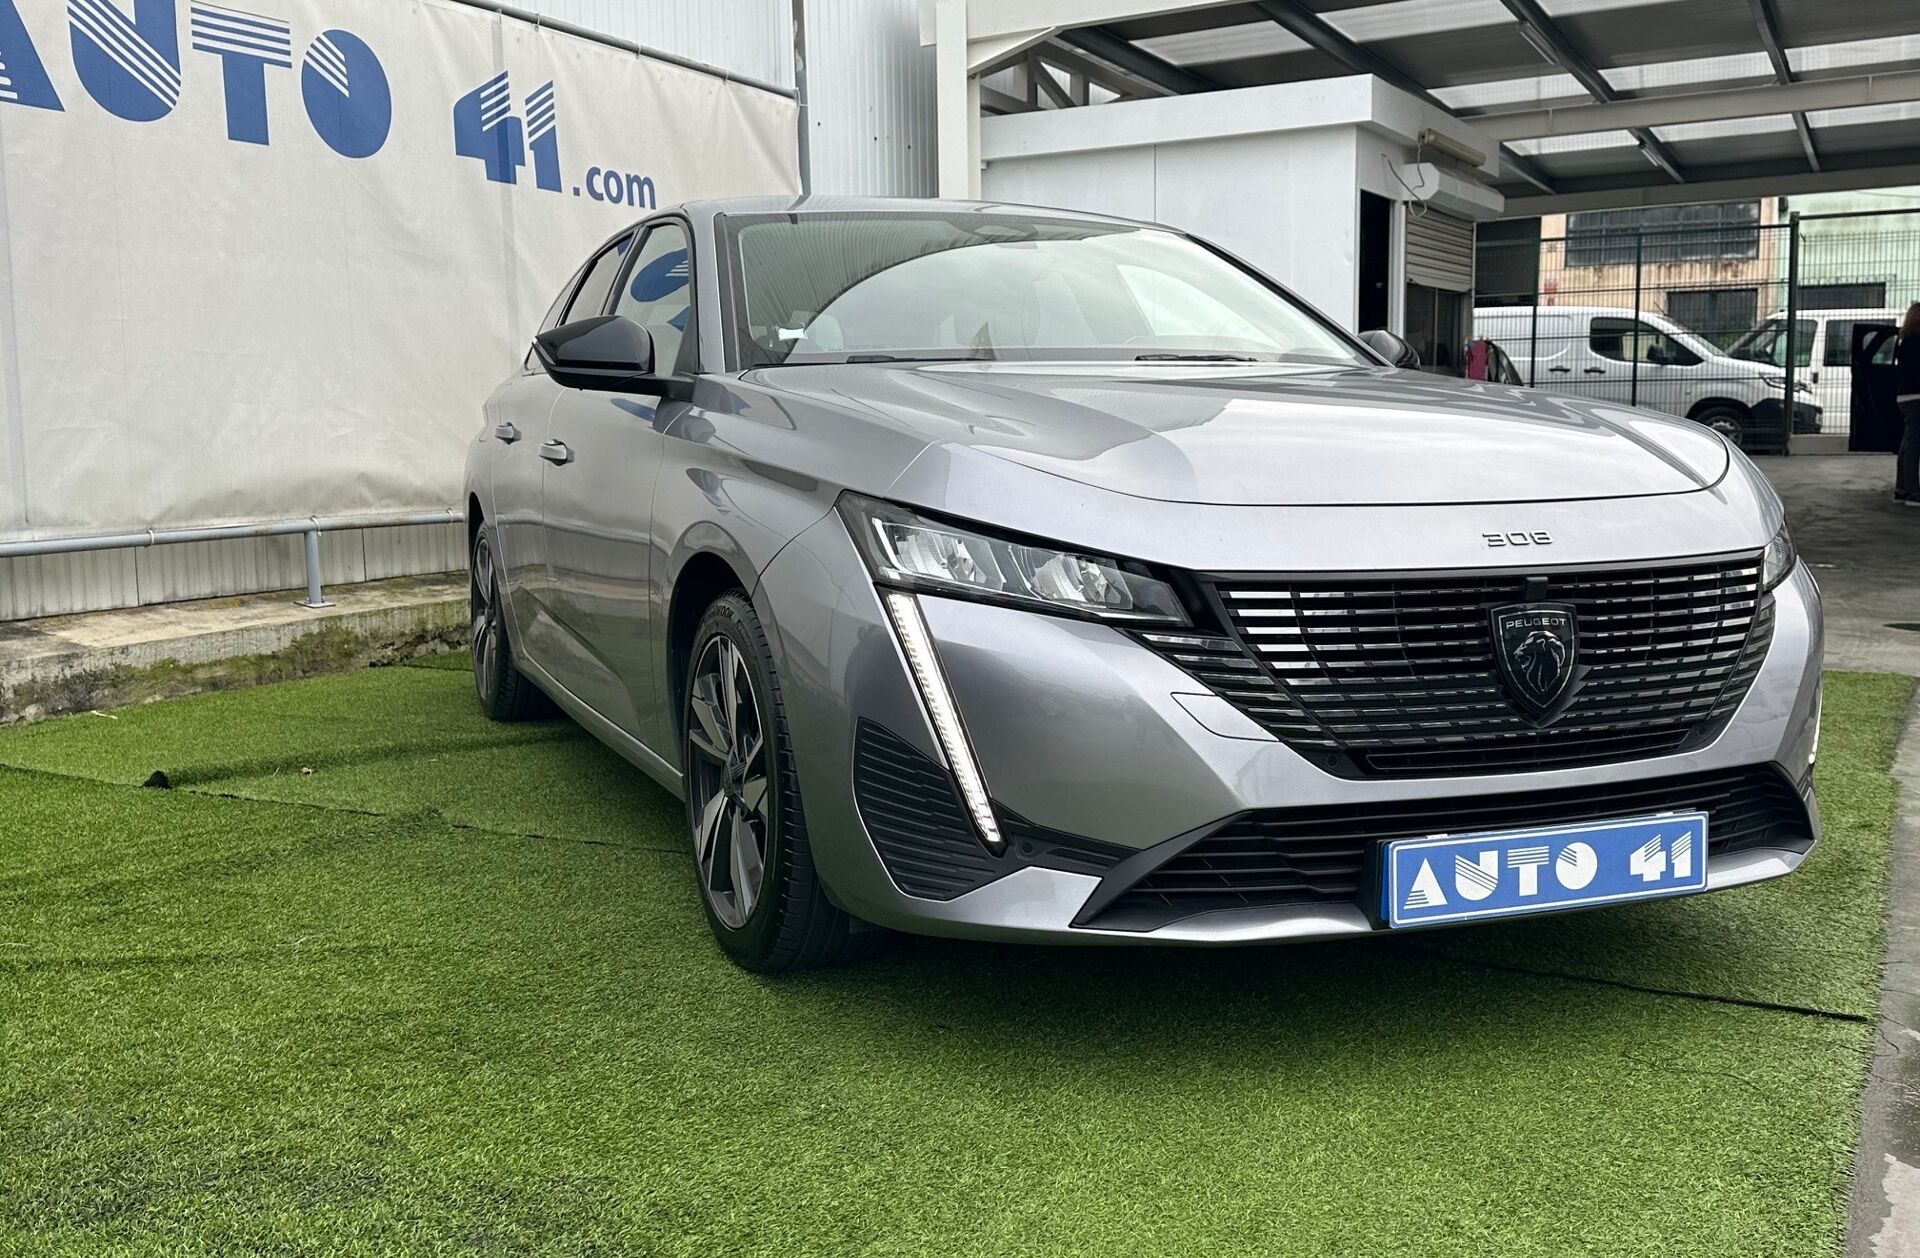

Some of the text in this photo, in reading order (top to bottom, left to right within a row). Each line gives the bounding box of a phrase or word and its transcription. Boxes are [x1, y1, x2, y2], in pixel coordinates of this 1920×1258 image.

[1482, 529, 1554, 547] 308
[1506, 617, 1566, 630] PEUGEOT
[1403, 831, 1692, 910] AUTO 41
